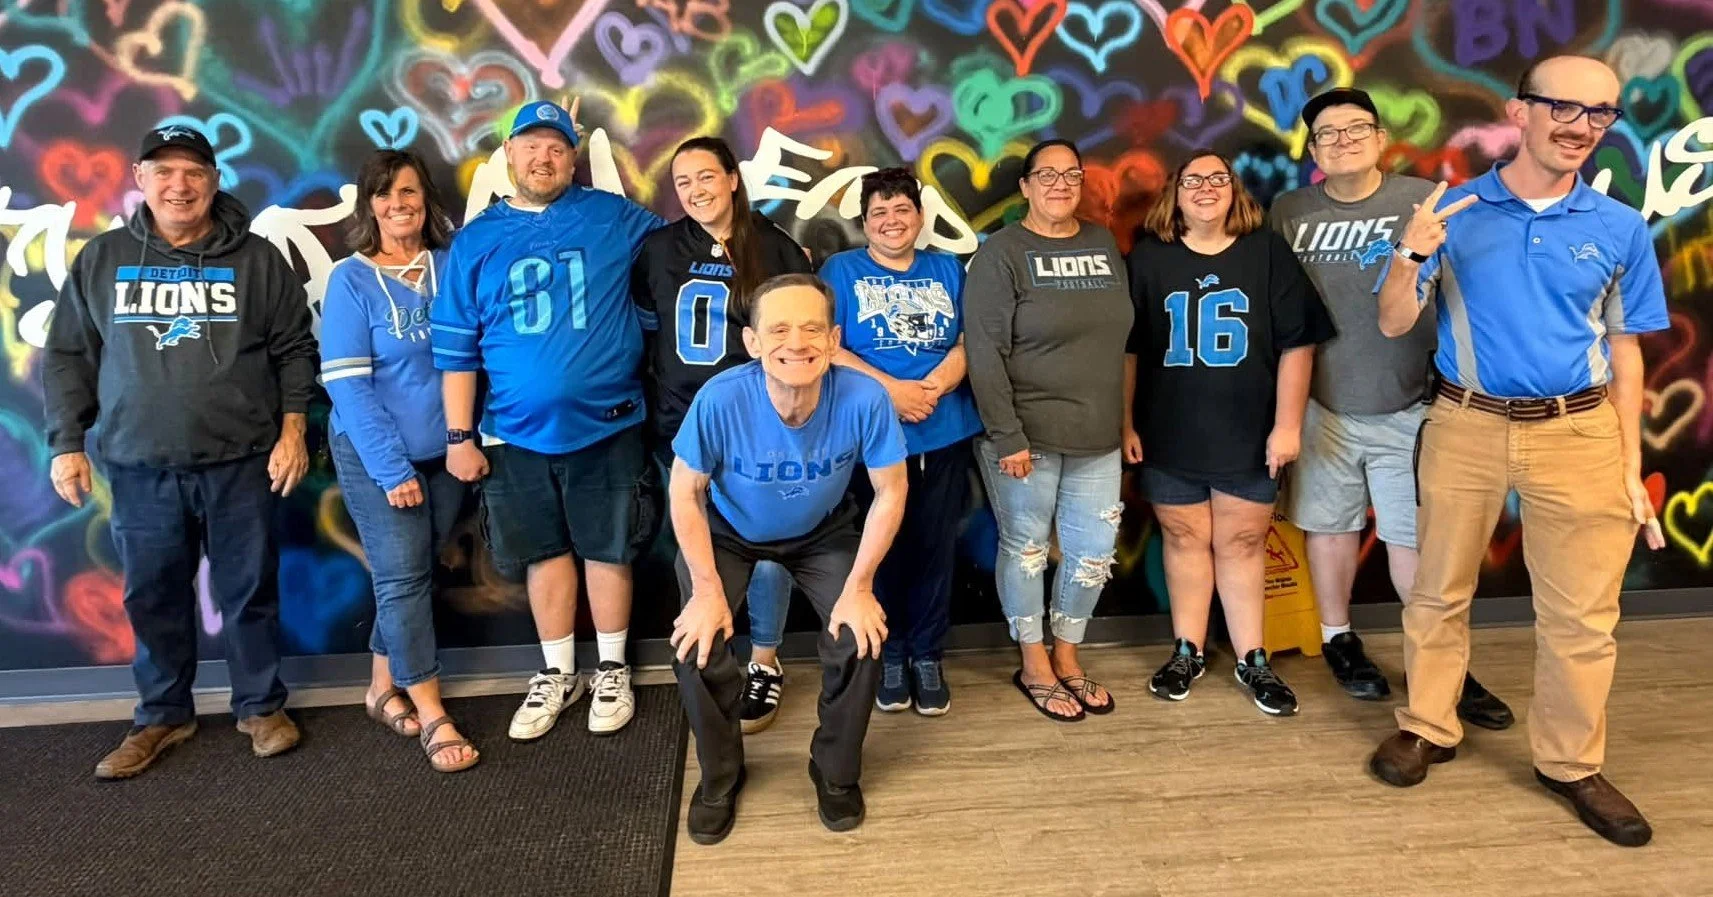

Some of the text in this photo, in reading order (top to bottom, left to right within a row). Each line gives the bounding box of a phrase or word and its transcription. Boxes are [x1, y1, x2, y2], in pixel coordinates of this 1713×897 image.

[1292, 216, 1400, 252] LIONS
[689, 261, 735, 277] LIONS
[1034, 254, 1113, 277] LIONS
[113, 281, 237, 315] LIONS
[1163, 288, 1249, 367] 16
[733, 448, 855, 483] LIONS
